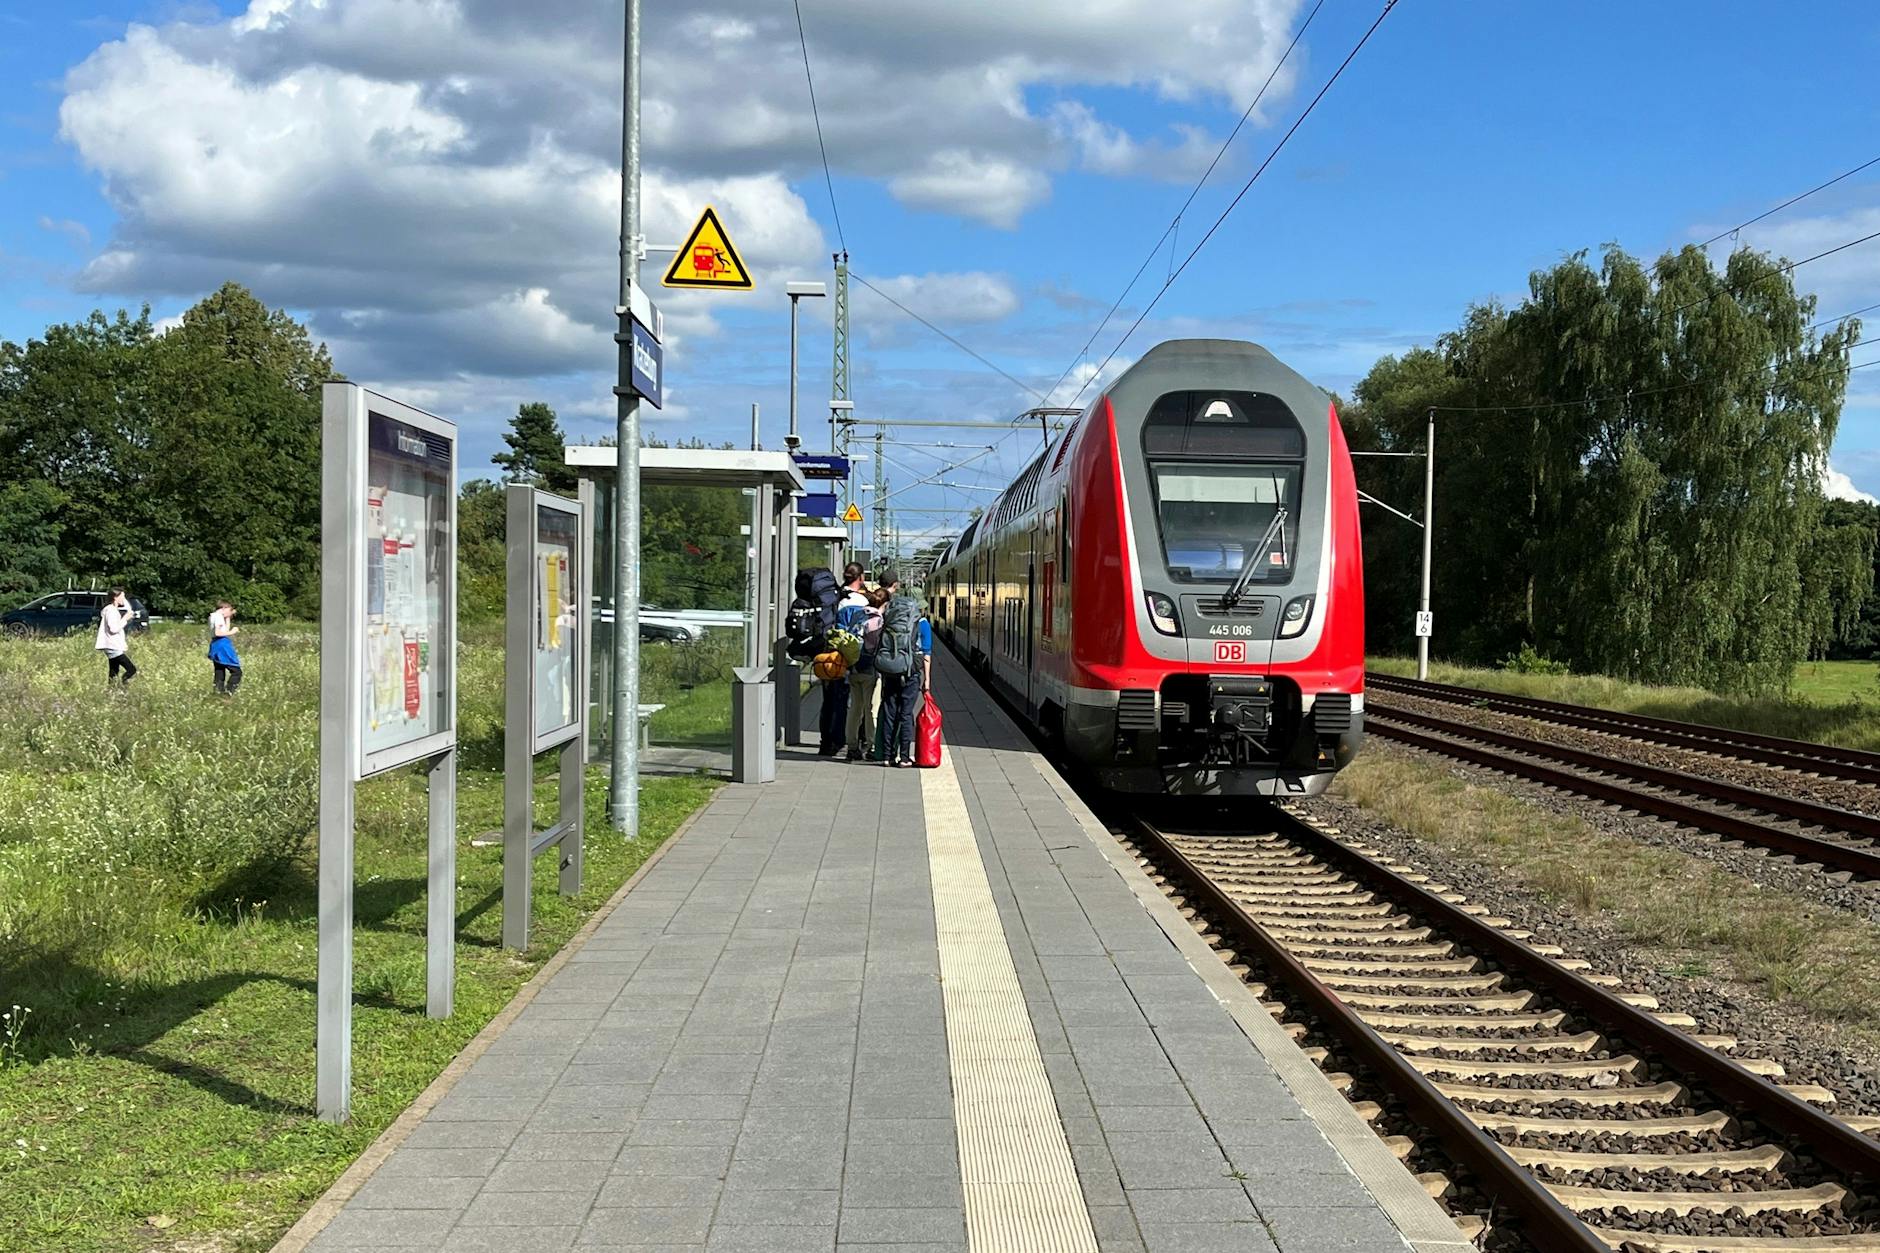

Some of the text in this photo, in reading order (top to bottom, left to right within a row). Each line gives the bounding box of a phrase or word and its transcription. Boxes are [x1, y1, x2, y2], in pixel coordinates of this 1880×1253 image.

[1419, 613, 1430, 623] 14
[1209, 624, 1253, 636] 445 006
[1420, 624, 1428, 634] 6
[1217, 644, 1242, 660] DB
